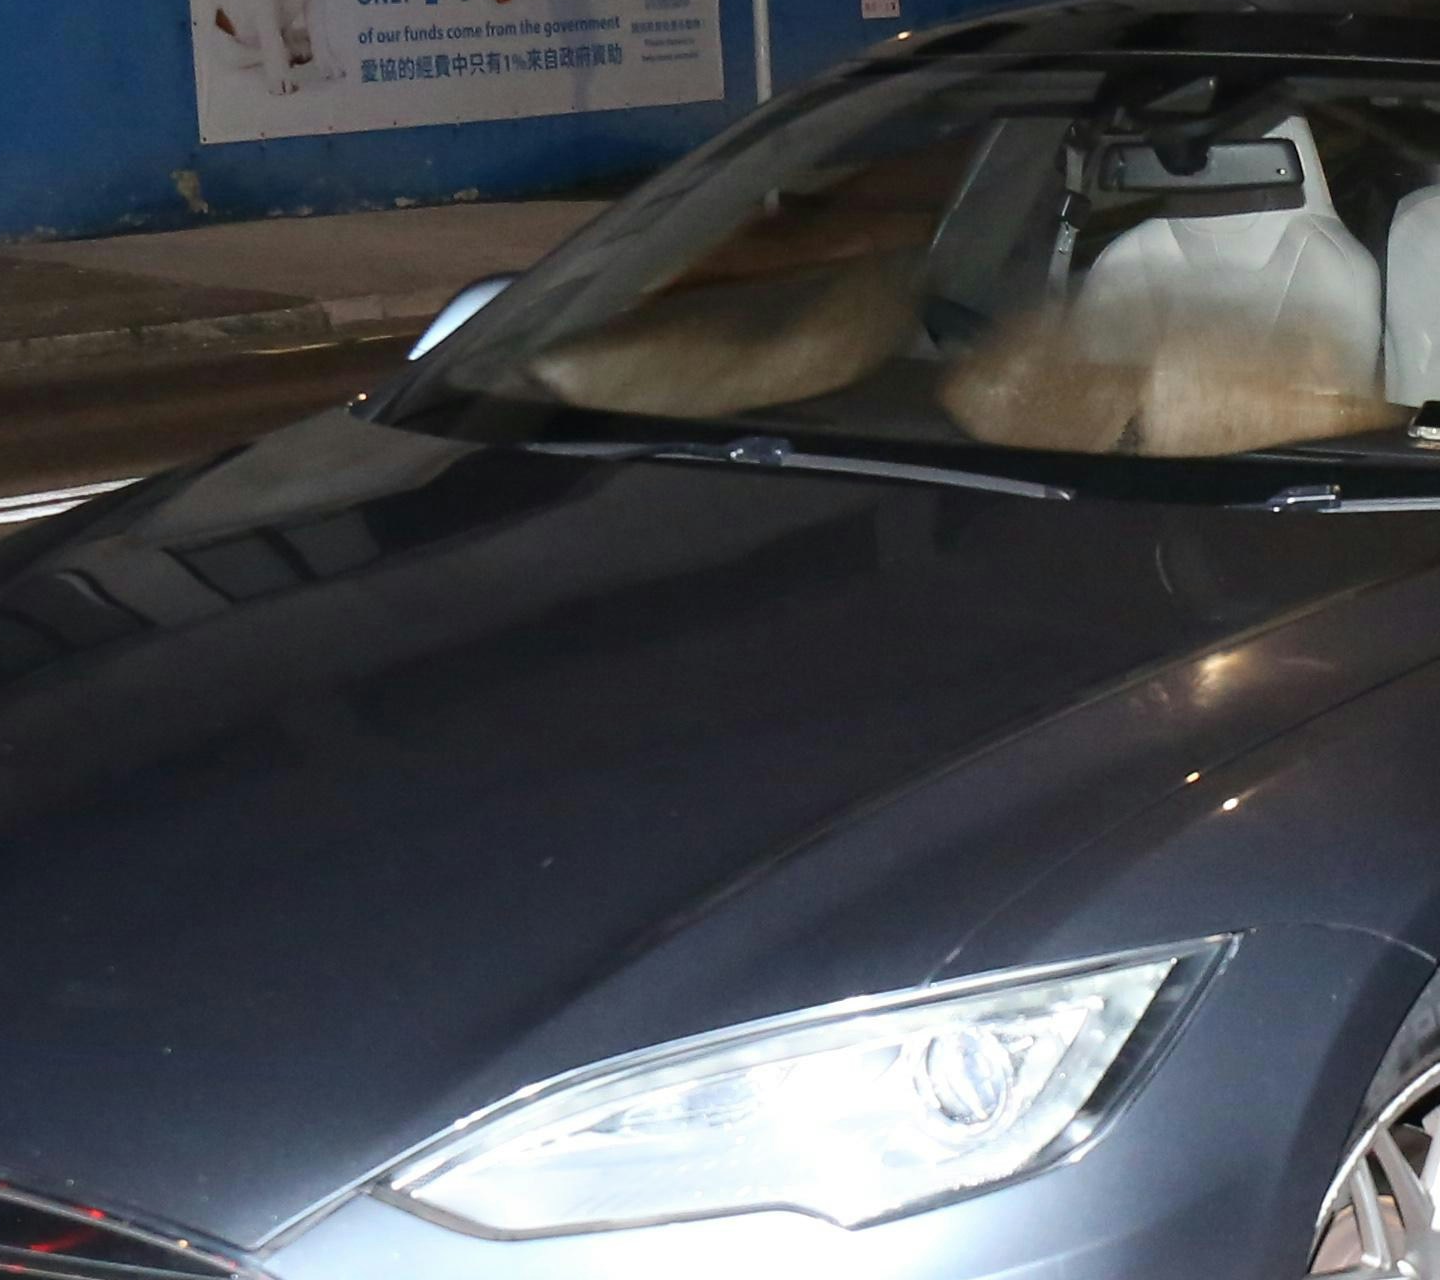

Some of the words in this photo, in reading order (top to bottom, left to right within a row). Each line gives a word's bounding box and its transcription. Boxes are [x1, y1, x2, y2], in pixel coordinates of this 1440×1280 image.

[358, 27, 374, 45] of
[377, 30, 401, 44] our
[405, 24, 443, 42] funds
[446, 26, 481, 40] come
[485, 21, 517, 39] from
[520, 17, 541, 36] the
[544, 16, 620, 38] government
